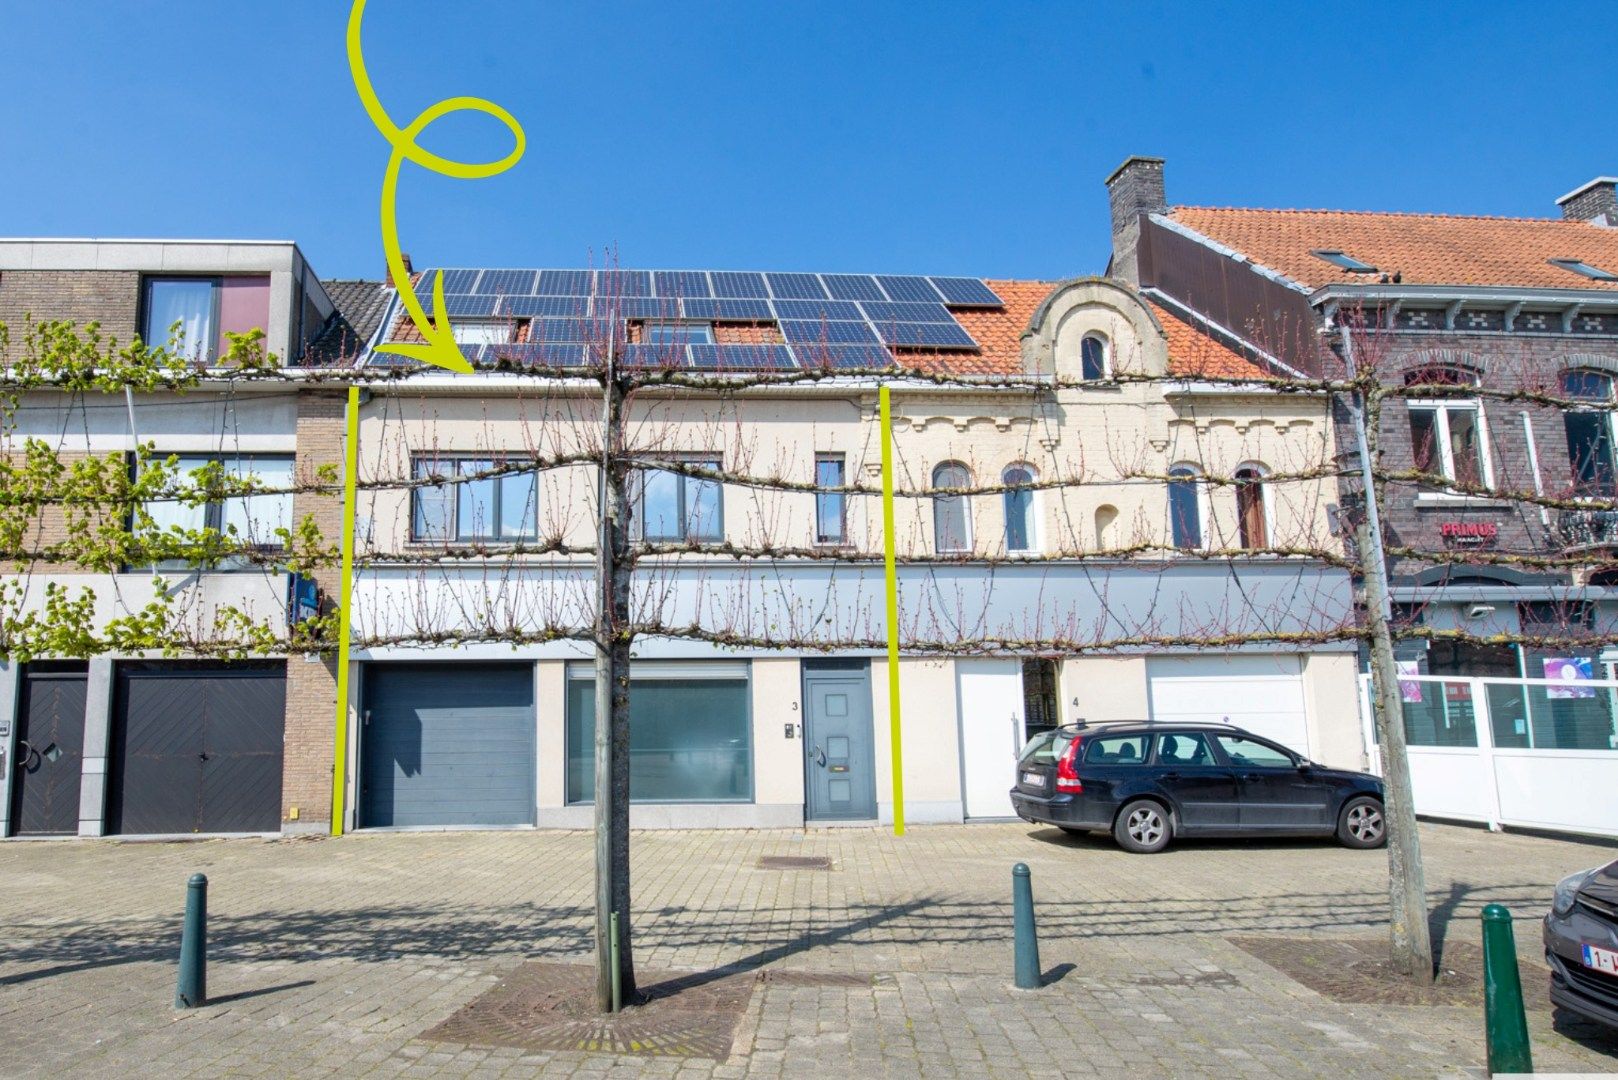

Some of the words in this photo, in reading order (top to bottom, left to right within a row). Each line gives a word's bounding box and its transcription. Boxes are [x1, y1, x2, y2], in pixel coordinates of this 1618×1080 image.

[1442, 523, 1497, 536] PRIMUS
[792, 701, 798, 711] 3
[1072, 696, 1079, 707] 4
